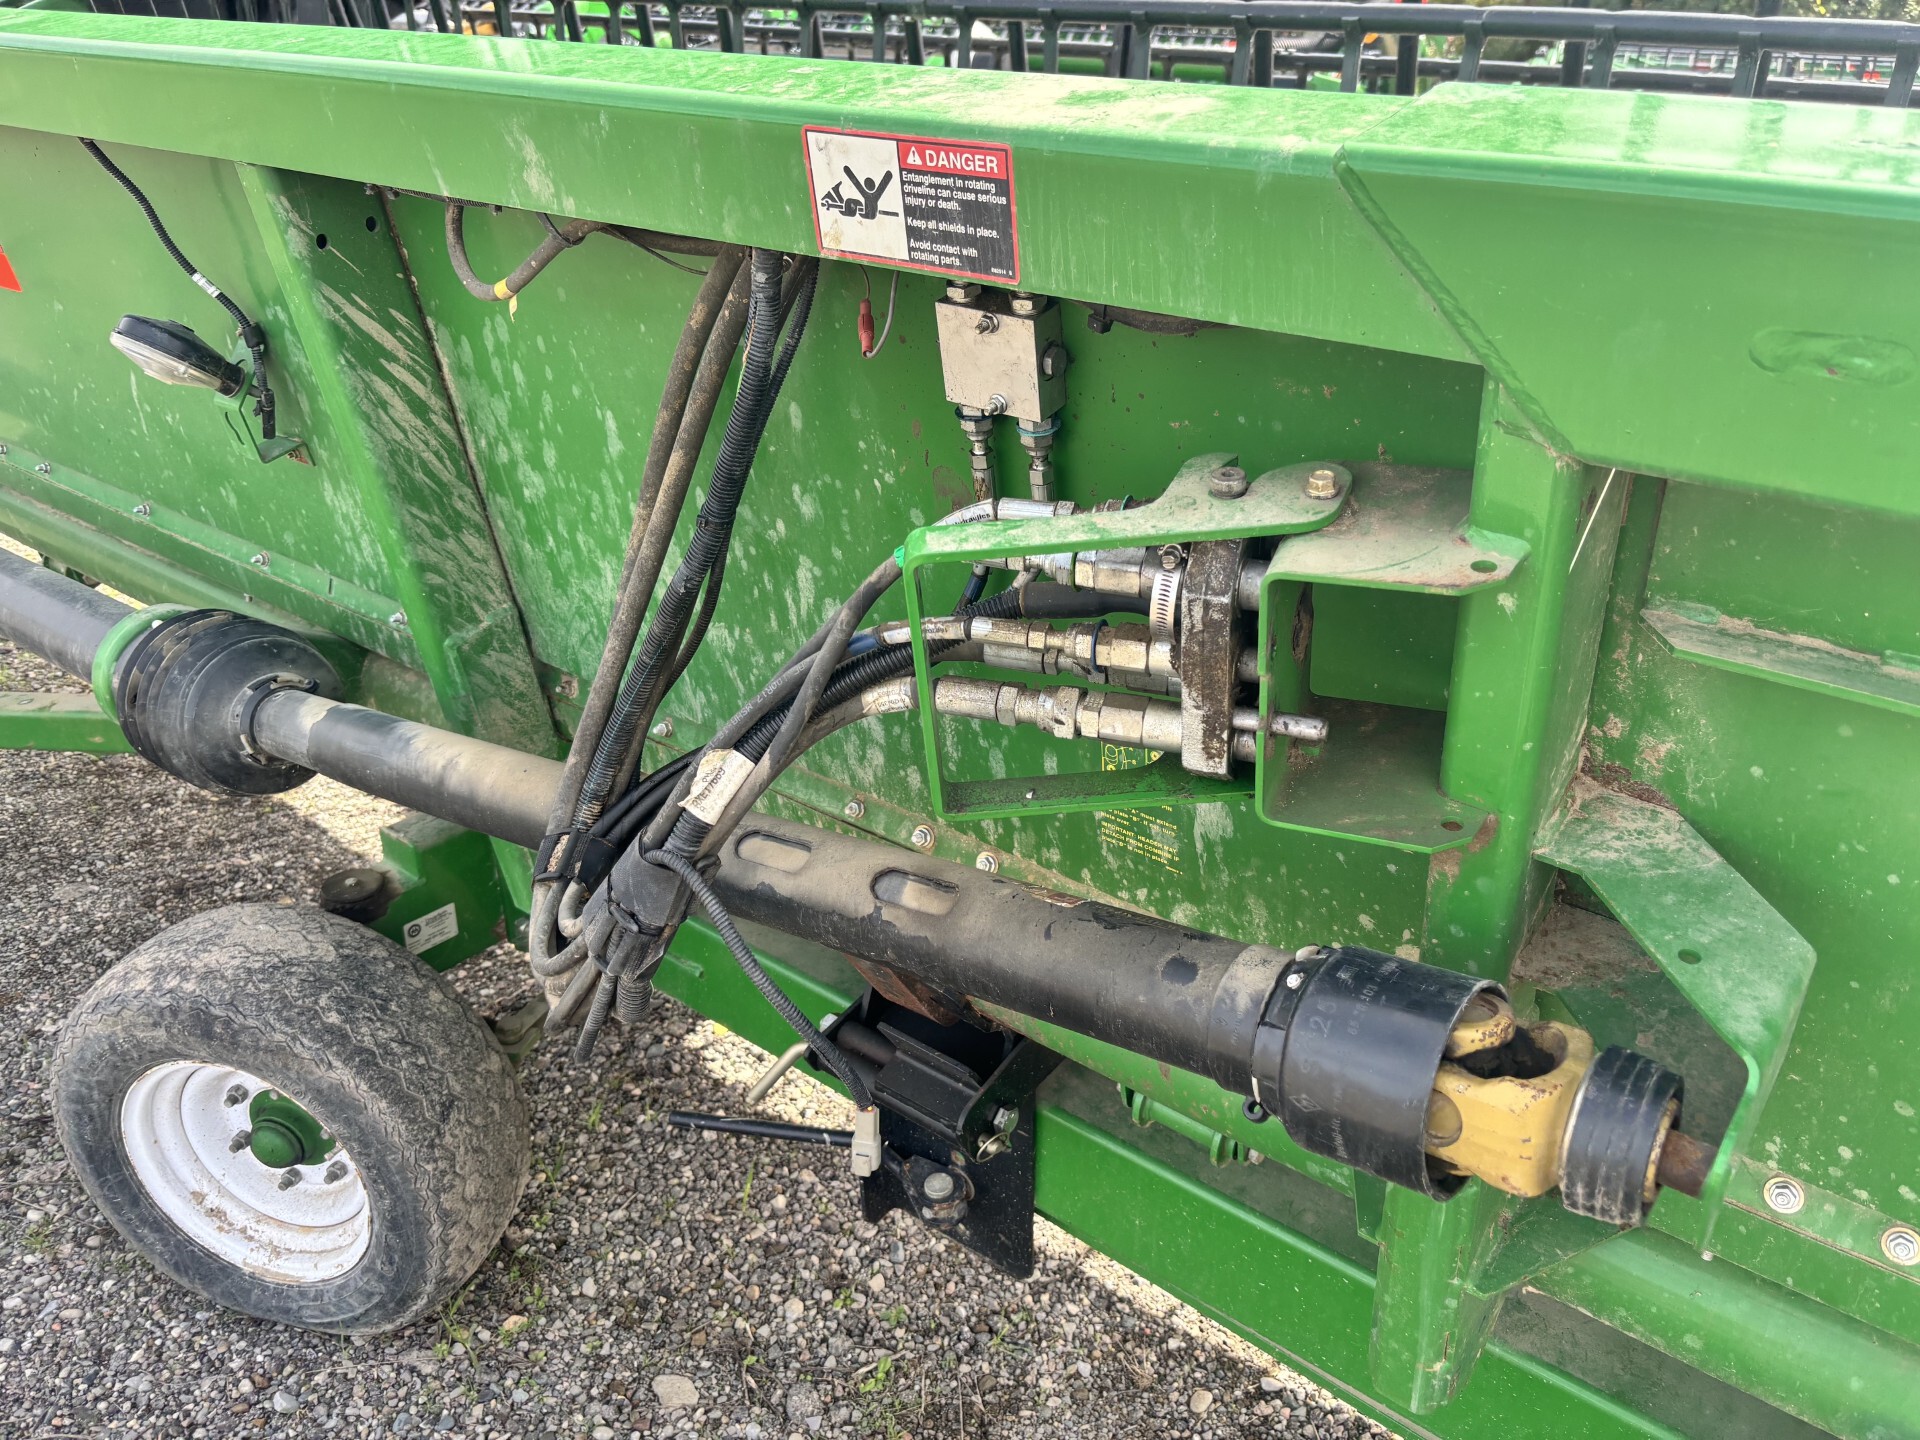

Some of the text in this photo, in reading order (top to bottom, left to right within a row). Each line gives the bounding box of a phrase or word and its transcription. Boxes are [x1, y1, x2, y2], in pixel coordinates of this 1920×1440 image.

[925, 150, 998, 173] DANGER
[902, 171, 996, 193] Entanglement in rotating
[904, 185, 1007, 204] driveline can cause serious
[904, 195, 926, 208] injury
[937, 200, 961, 210] death.
[907, 217, 1000, 238] Keep all shields in place.
[910, 239, 978, 257] Avoid contact with
[911, 251, 962, 266] rotating parts.
[1140, 812, 1155, 822] must
[1156, 819, 1177, 830] extend
[1101, 828, 1125, 840] DETACH
[1125, 837, 1143, 848] FROM
[1144, 844, 1173, 859] COMBINE
[1137, 835, 1163, 848] HEADER
[1163, 845, 1177, 854] MAY
[1133, 847, 1144, 855] not
[1152, 856, 1169, 865] place.
